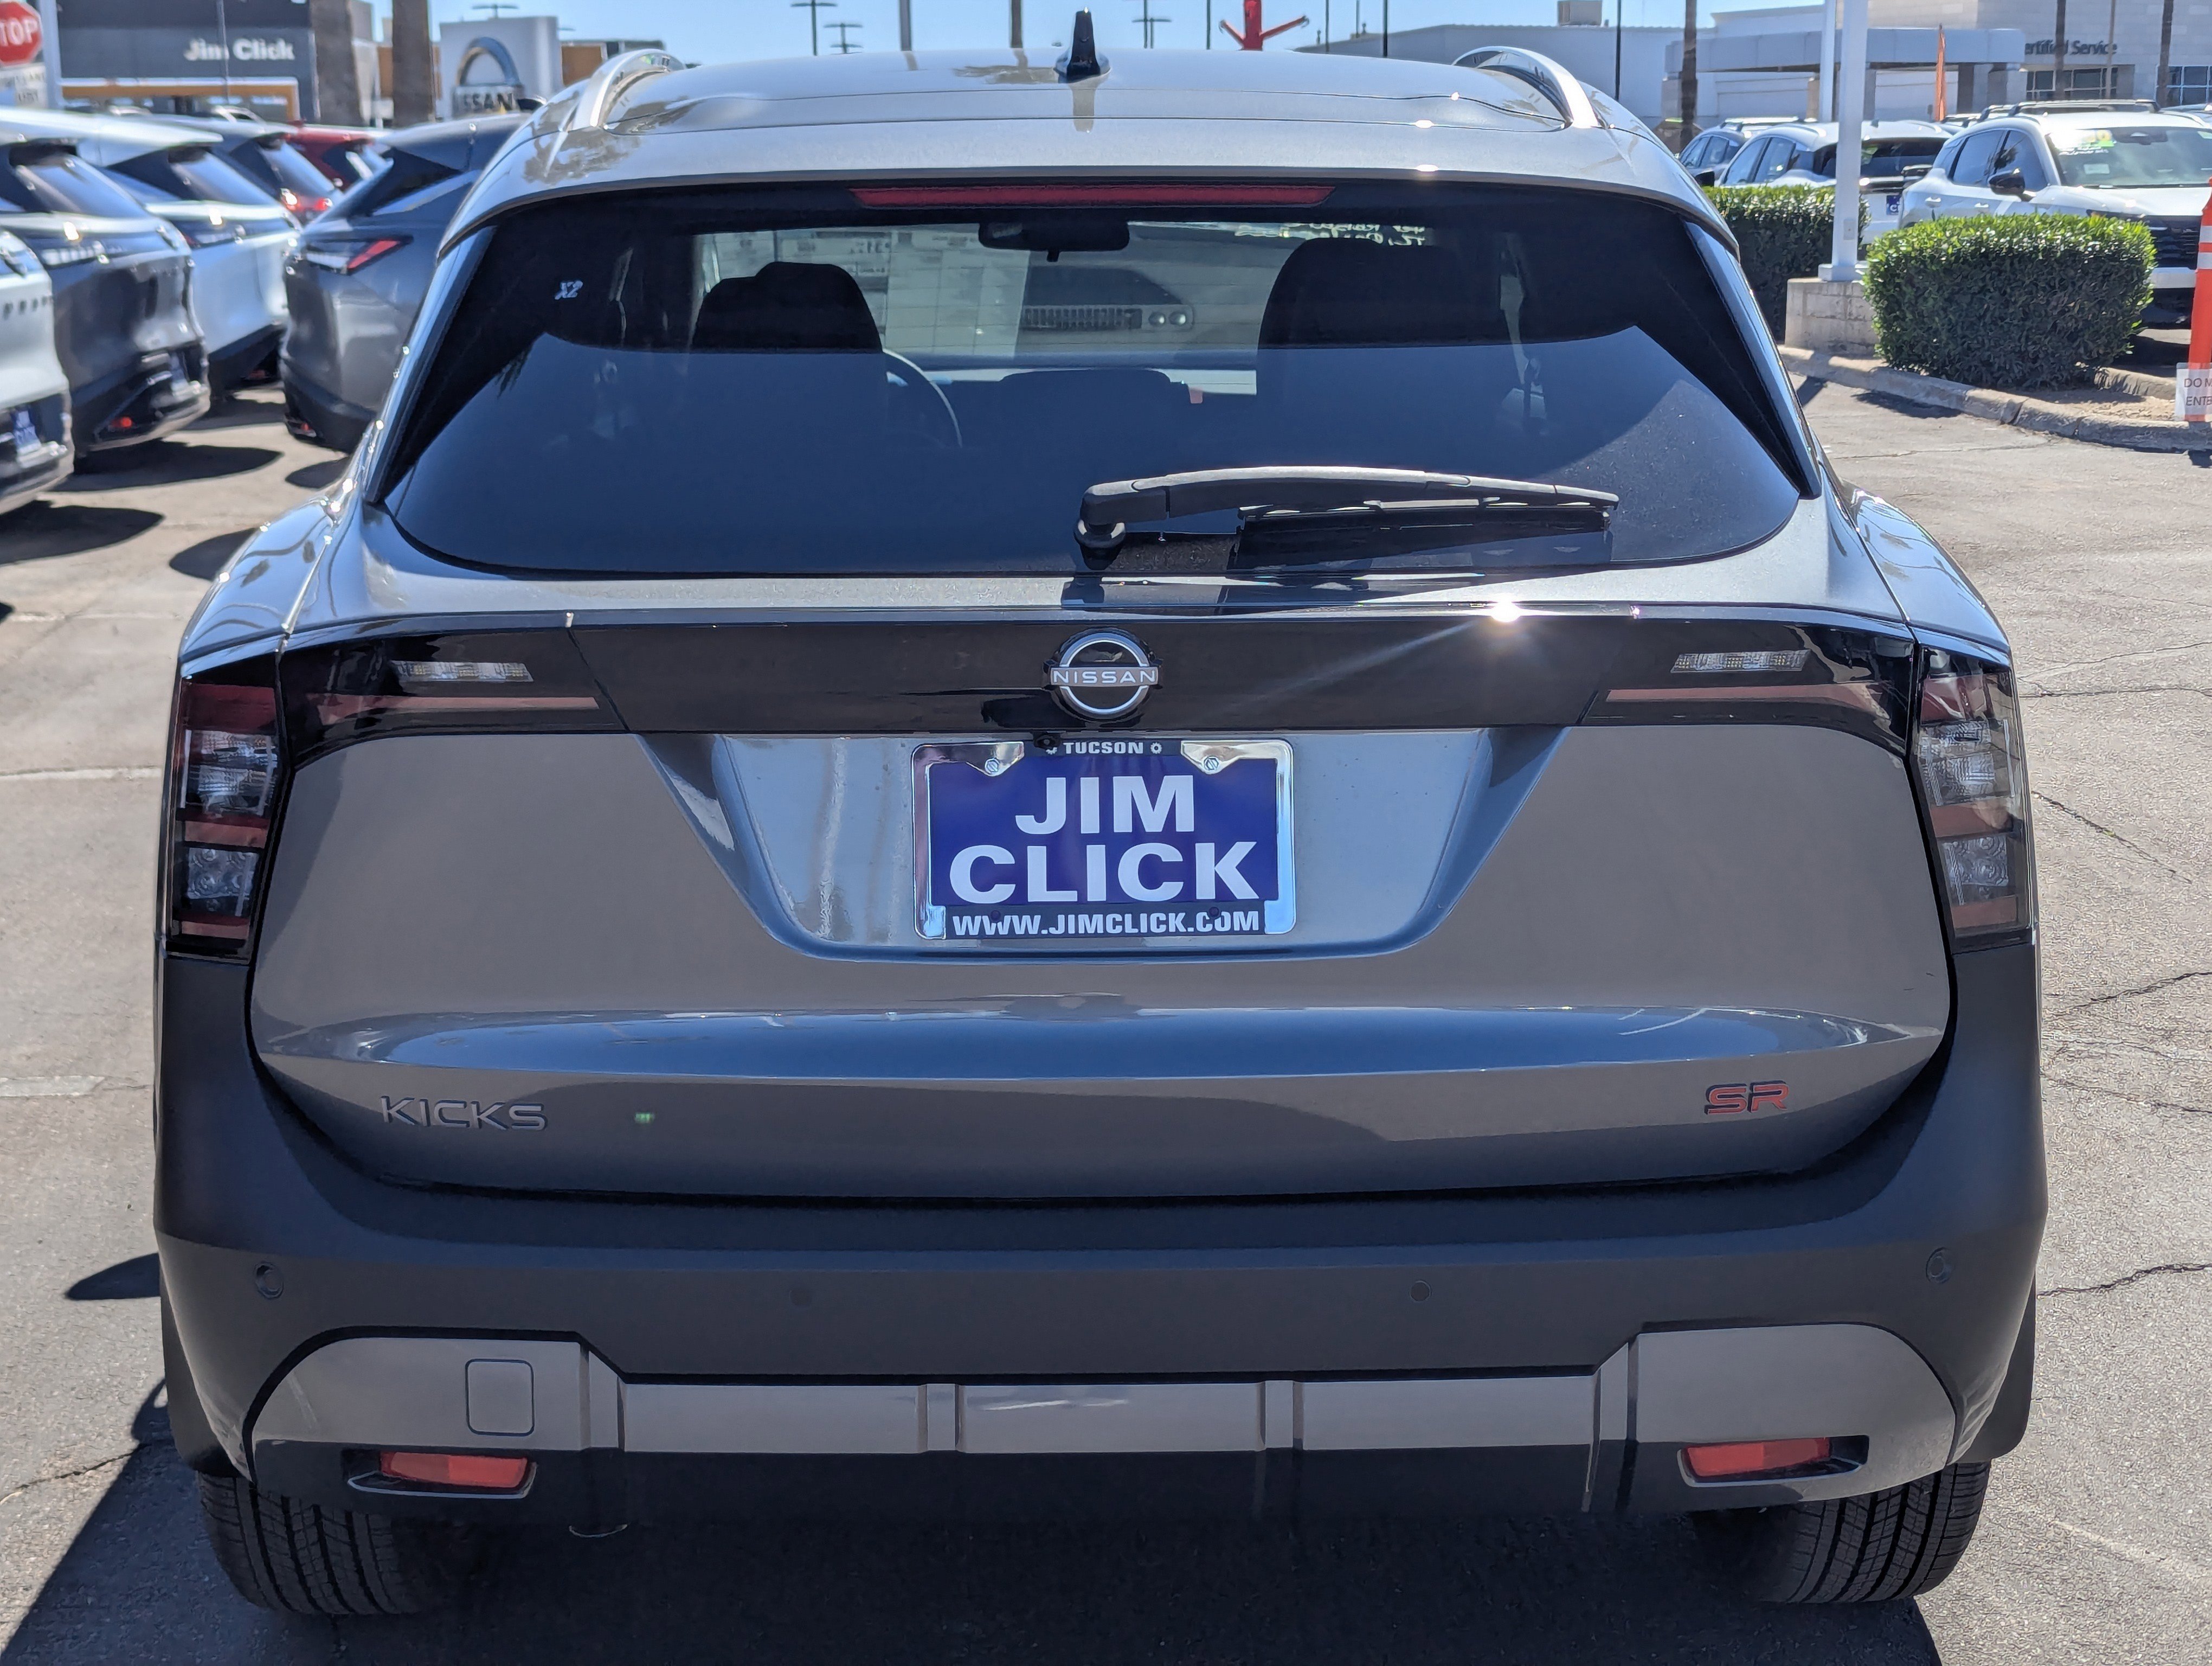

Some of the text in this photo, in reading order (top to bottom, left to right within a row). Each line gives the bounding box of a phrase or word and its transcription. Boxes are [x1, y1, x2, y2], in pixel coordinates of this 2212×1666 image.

[0, 18, 38, 47] TOP
[184, 38, 295, 61] Jim Click
[2071, 40, 2117, 55] Service
[464, 93, 513, 110] SSAN
[2184, 377, 2202, 388] DO
[2186, 396, 2212, 406] ENTE
[1053, 670, 1156, 684] NISSAN
[1063, 741, 1144, 754] TUCSON
[1015, 775, 1195, 835] JIM
[949, 841, 1260, 905] CLICK
[952, 911, 1259, 935] WWW.JIMCLICK.COM
[1704, 1080, 1789, 1114] SR
[380, 1095, 548, 1131] KICKS
